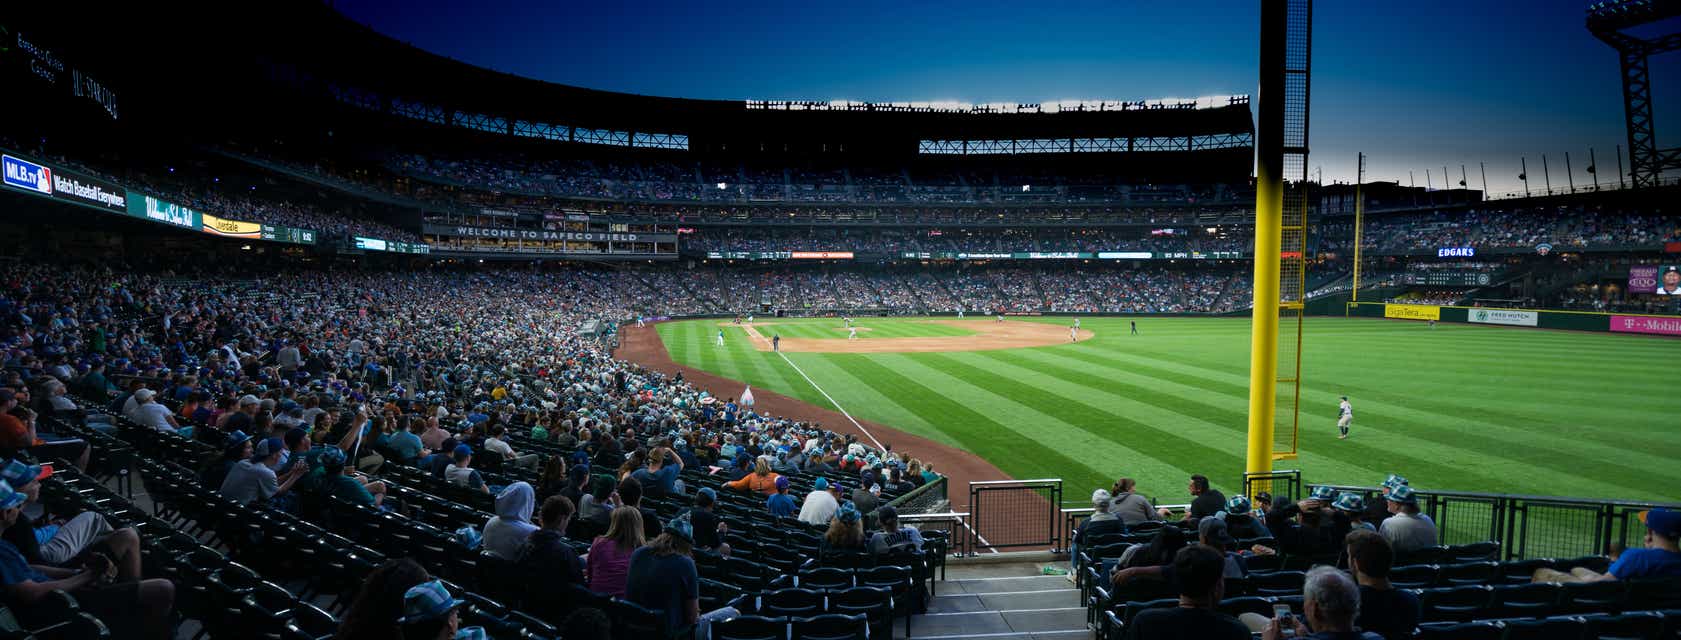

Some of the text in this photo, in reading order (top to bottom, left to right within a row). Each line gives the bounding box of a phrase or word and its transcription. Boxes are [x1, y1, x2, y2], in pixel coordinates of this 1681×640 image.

[6, 161, 37, 185] MLB.TV
[53, 174, 74, 195] Watch
[74, 180, 98, 201] Baseball
[457, 226, 516, 238] WELCOME
[520, 230, 538, 238] TO
[543, 231, 593, 240] SAFECO
